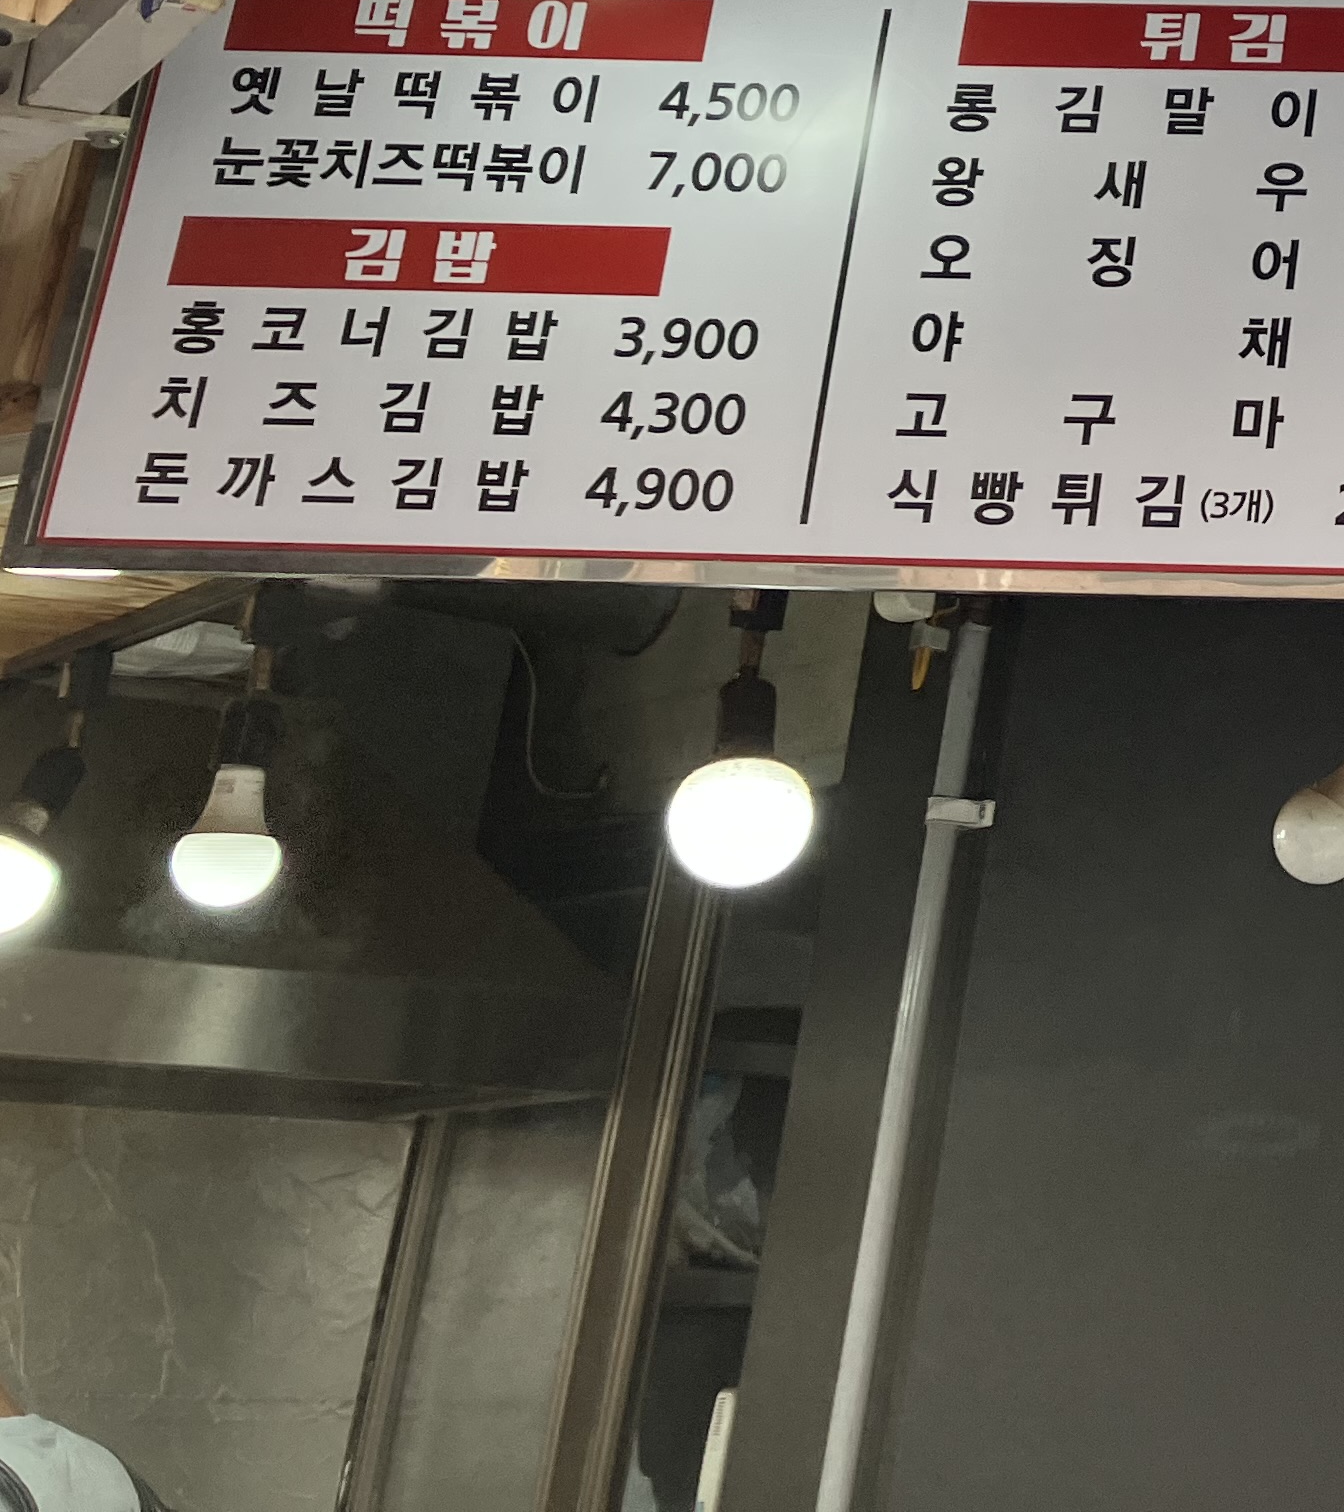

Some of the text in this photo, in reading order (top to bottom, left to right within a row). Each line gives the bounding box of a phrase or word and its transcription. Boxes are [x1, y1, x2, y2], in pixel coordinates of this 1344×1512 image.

[1141, 14, 1286, 63] 튀김
[658, 81, 799, 127] 4,500
[213, 136, 786, 198] 눈꽃치즈떡볶이 7,000
[345, 229, 496, 283] 김밥
[613, 317, 759, 365] 3,900
[600, 391, 746, 440] 4,300
[584, 467, 734, 517] 4,900
[1200, 489, 1274, 524] (3개)
